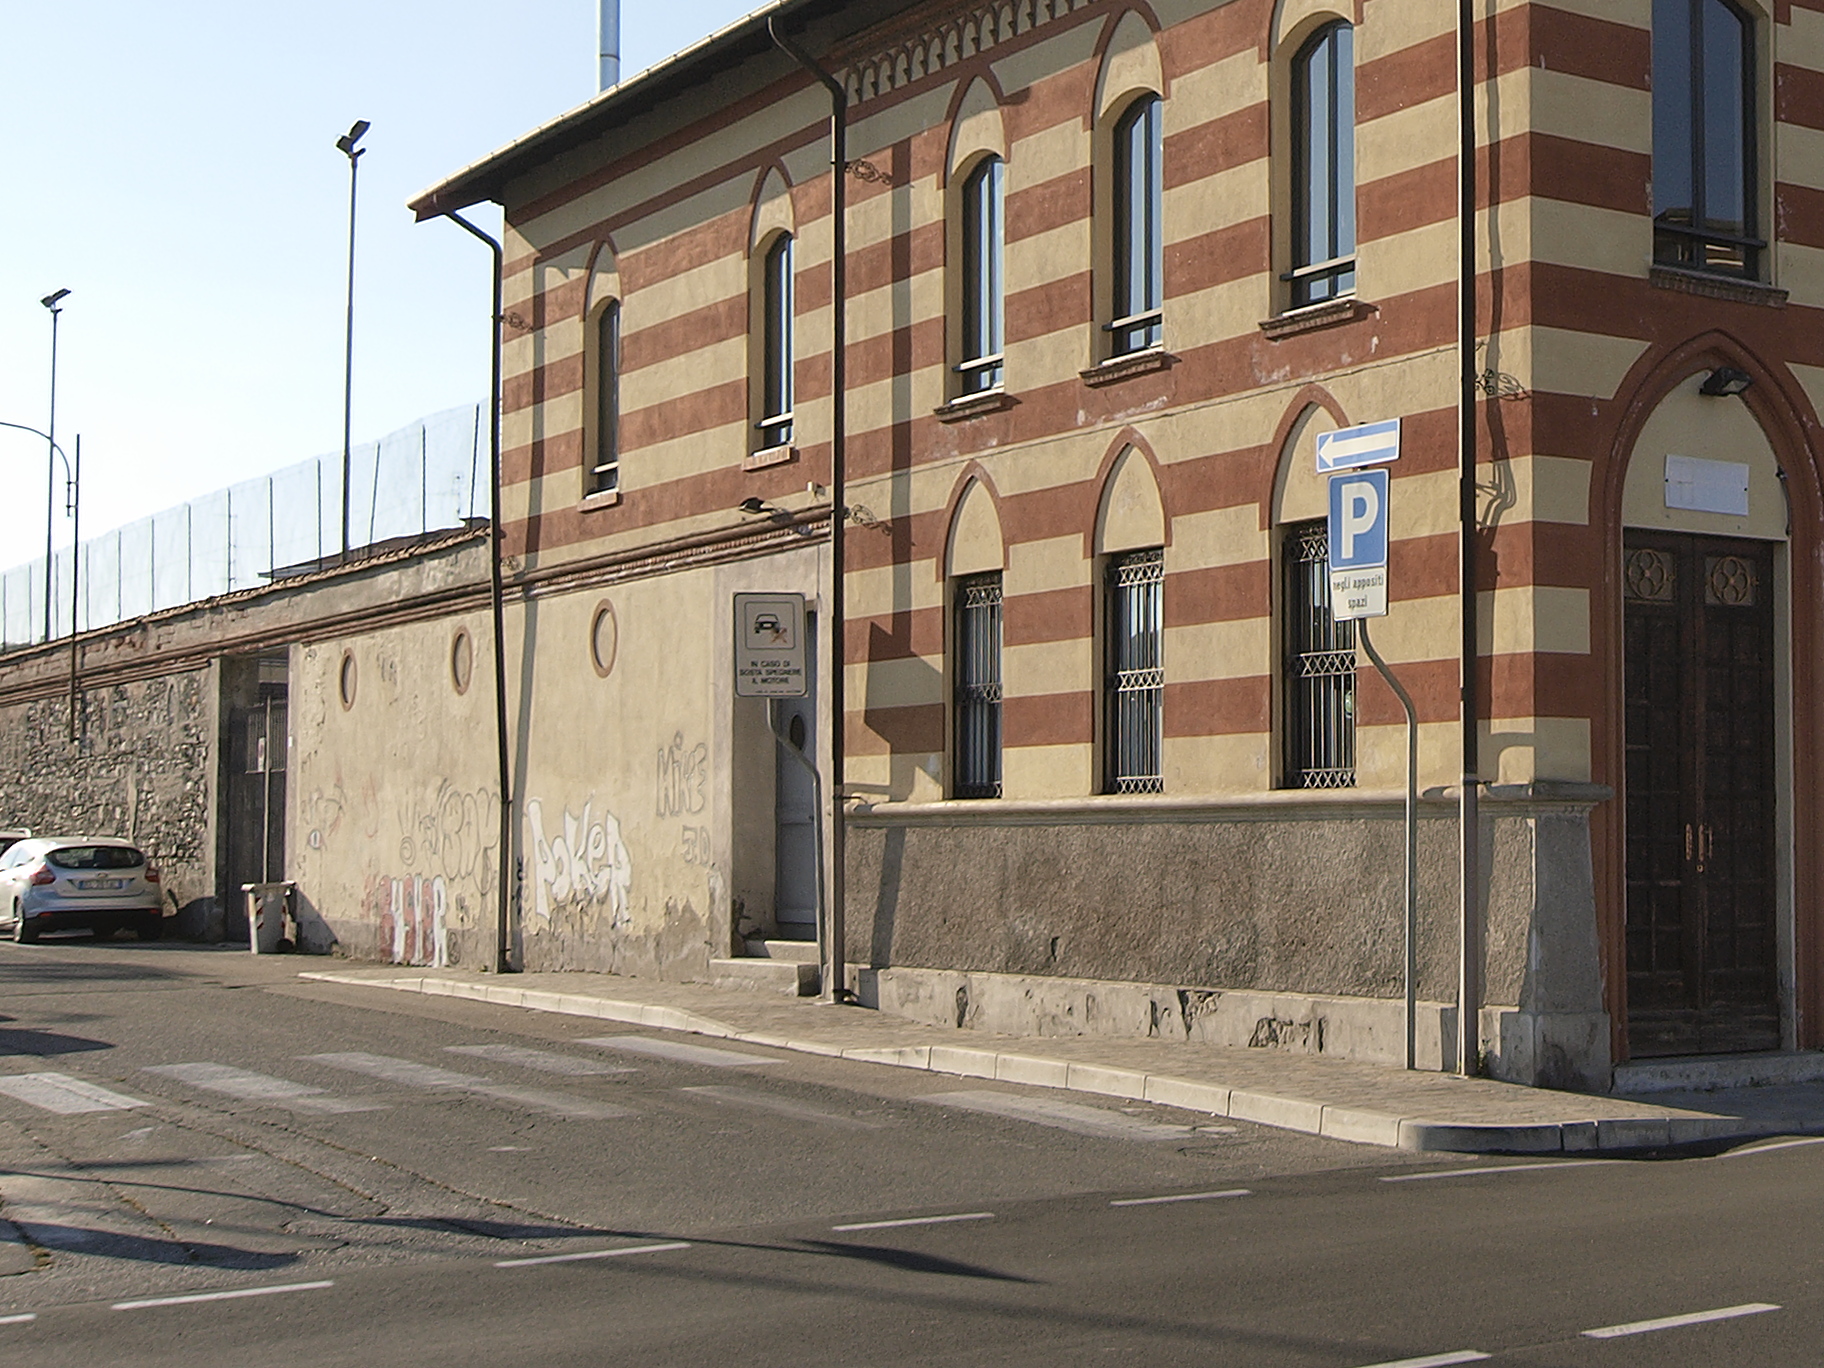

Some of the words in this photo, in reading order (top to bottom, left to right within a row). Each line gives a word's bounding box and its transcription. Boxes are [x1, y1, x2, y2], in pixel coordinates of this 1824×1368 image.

[1341, 481, 1379, 560] P
[1333, 577, 1351, 594] negli
[1353, 573, 1384, 590] appositi
[1348, 595, 1368, 610] spazi
